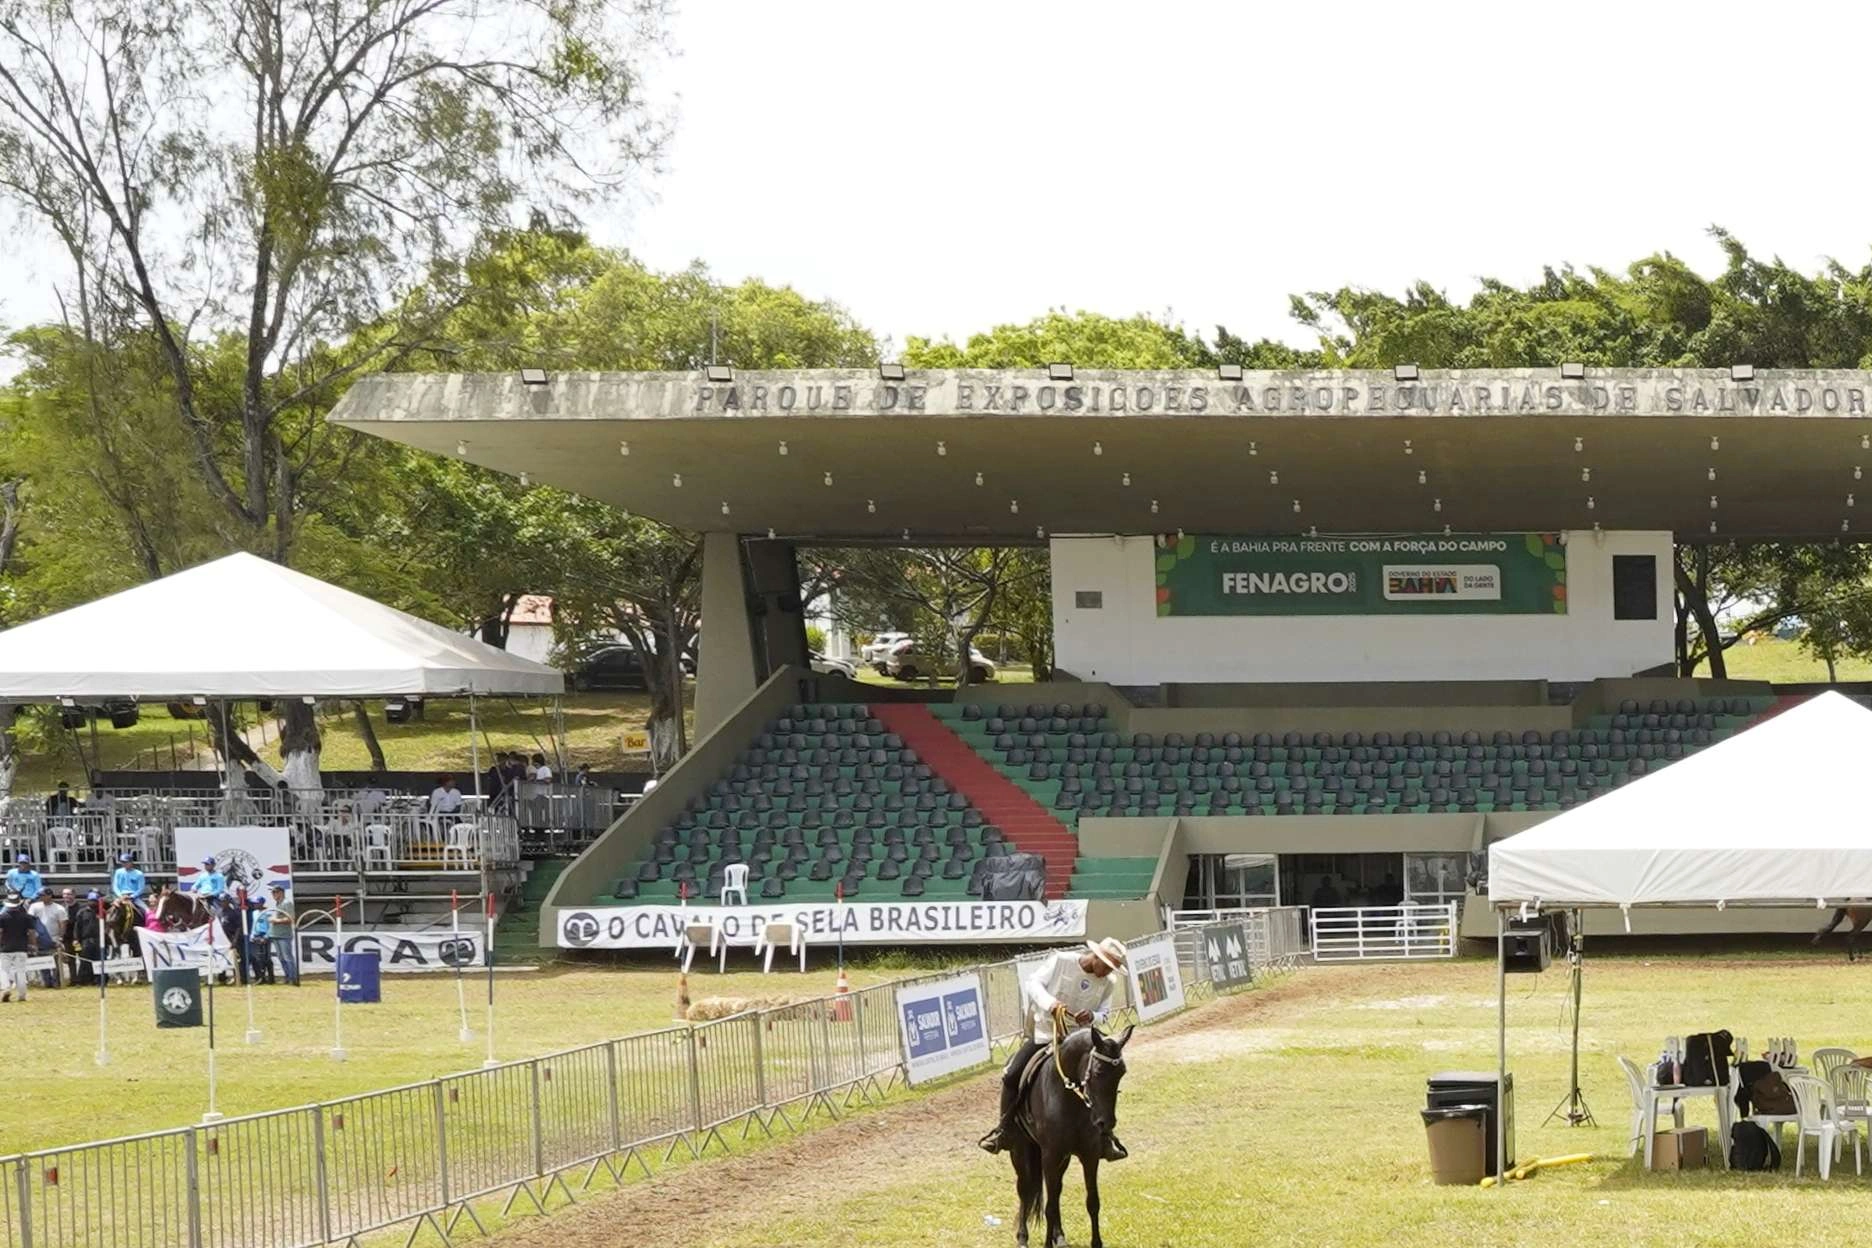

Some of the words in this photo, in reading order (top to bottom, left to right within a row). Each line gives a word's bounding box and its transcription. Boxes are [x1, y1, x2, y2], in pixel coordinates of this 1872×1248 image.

[695, 385, 851, 411] PARQUE
[879, 385, 928, 411] DE
[1592, 386, 1638, 412] DE
[1665, 387, 1866, 412] SALVADOR
[1210, 541, 1218, 553] É
[1221, 542, 1230, 553] A
[1232, 542, 1271, 553] BAHIA
[1272, 542, 1298, 553] PRA
[1300, 541, 1346, 553] FRENTE
[1350, 541, 1381, 552] COM
[1382, 541, 1393, 552] A
[1394, 541, 1437, 554] FORÇA
[1438, 541, 1458, 552] DO
[1459, 541, 1507, 552] CAMPO
[1222, 571, 1349, 594] FENAGRO
[1389, 577, 1458, 593] BAHIA
[635, 913, 740, 938] CAVO
[795, 907, 859, 933] SELA
[869, 904, 1036, 931] BRASILEIRO
